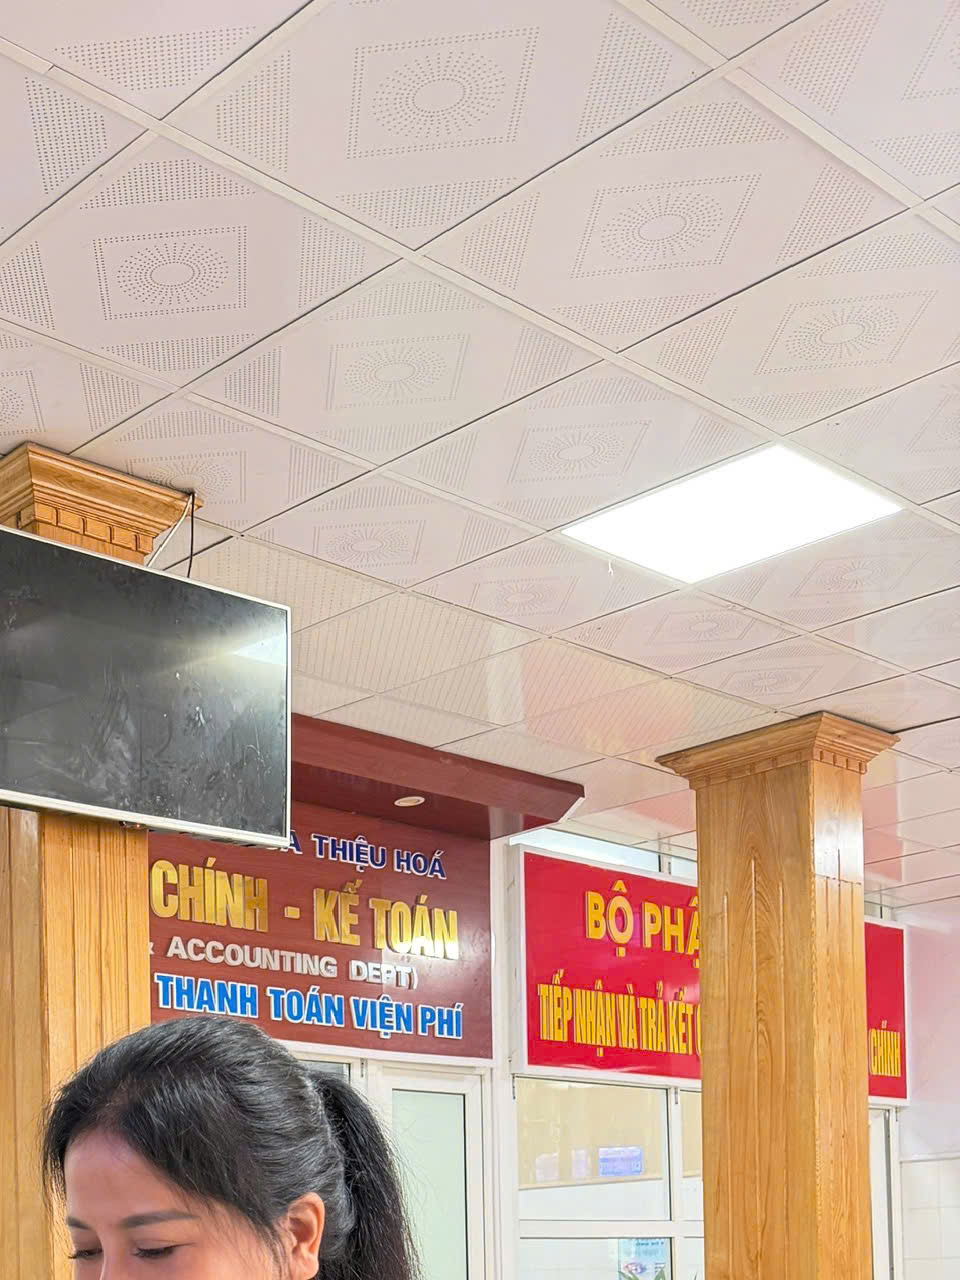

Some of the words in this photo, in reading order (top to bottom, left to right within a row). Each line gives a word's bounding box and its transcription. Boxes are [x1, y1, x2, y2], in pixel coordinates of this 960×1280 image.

[311, 835, 387, 873] THIỆU
[393, 849, 447, 880] HOÁ
[151, 857, 268, 932] CHÍNH
[313, 879, 363, 946] KẾ
[368, 894, 459, 960] TOÁN
[585, 879, 634, 957] BỘ
[642, 896, 700, 969] PHẬ
[167, 936, 338, 978] ACCOUNTING
[155, 973, 258, 1018] THANH
[266, 986, 345, 1027] TOÁN
[350, 994, 414, 1039] VIỆN
[416, 1002, 464, 1039] PHÍ
[538, 968, 573, 1042] TIẾP
[573, 979, 617, 1057] NHẬN
[617, 984, 639, 1049] VÀ
[638, 980, 667, 1052] TRẢ
[668, 986, 694, 1055] KẾT
